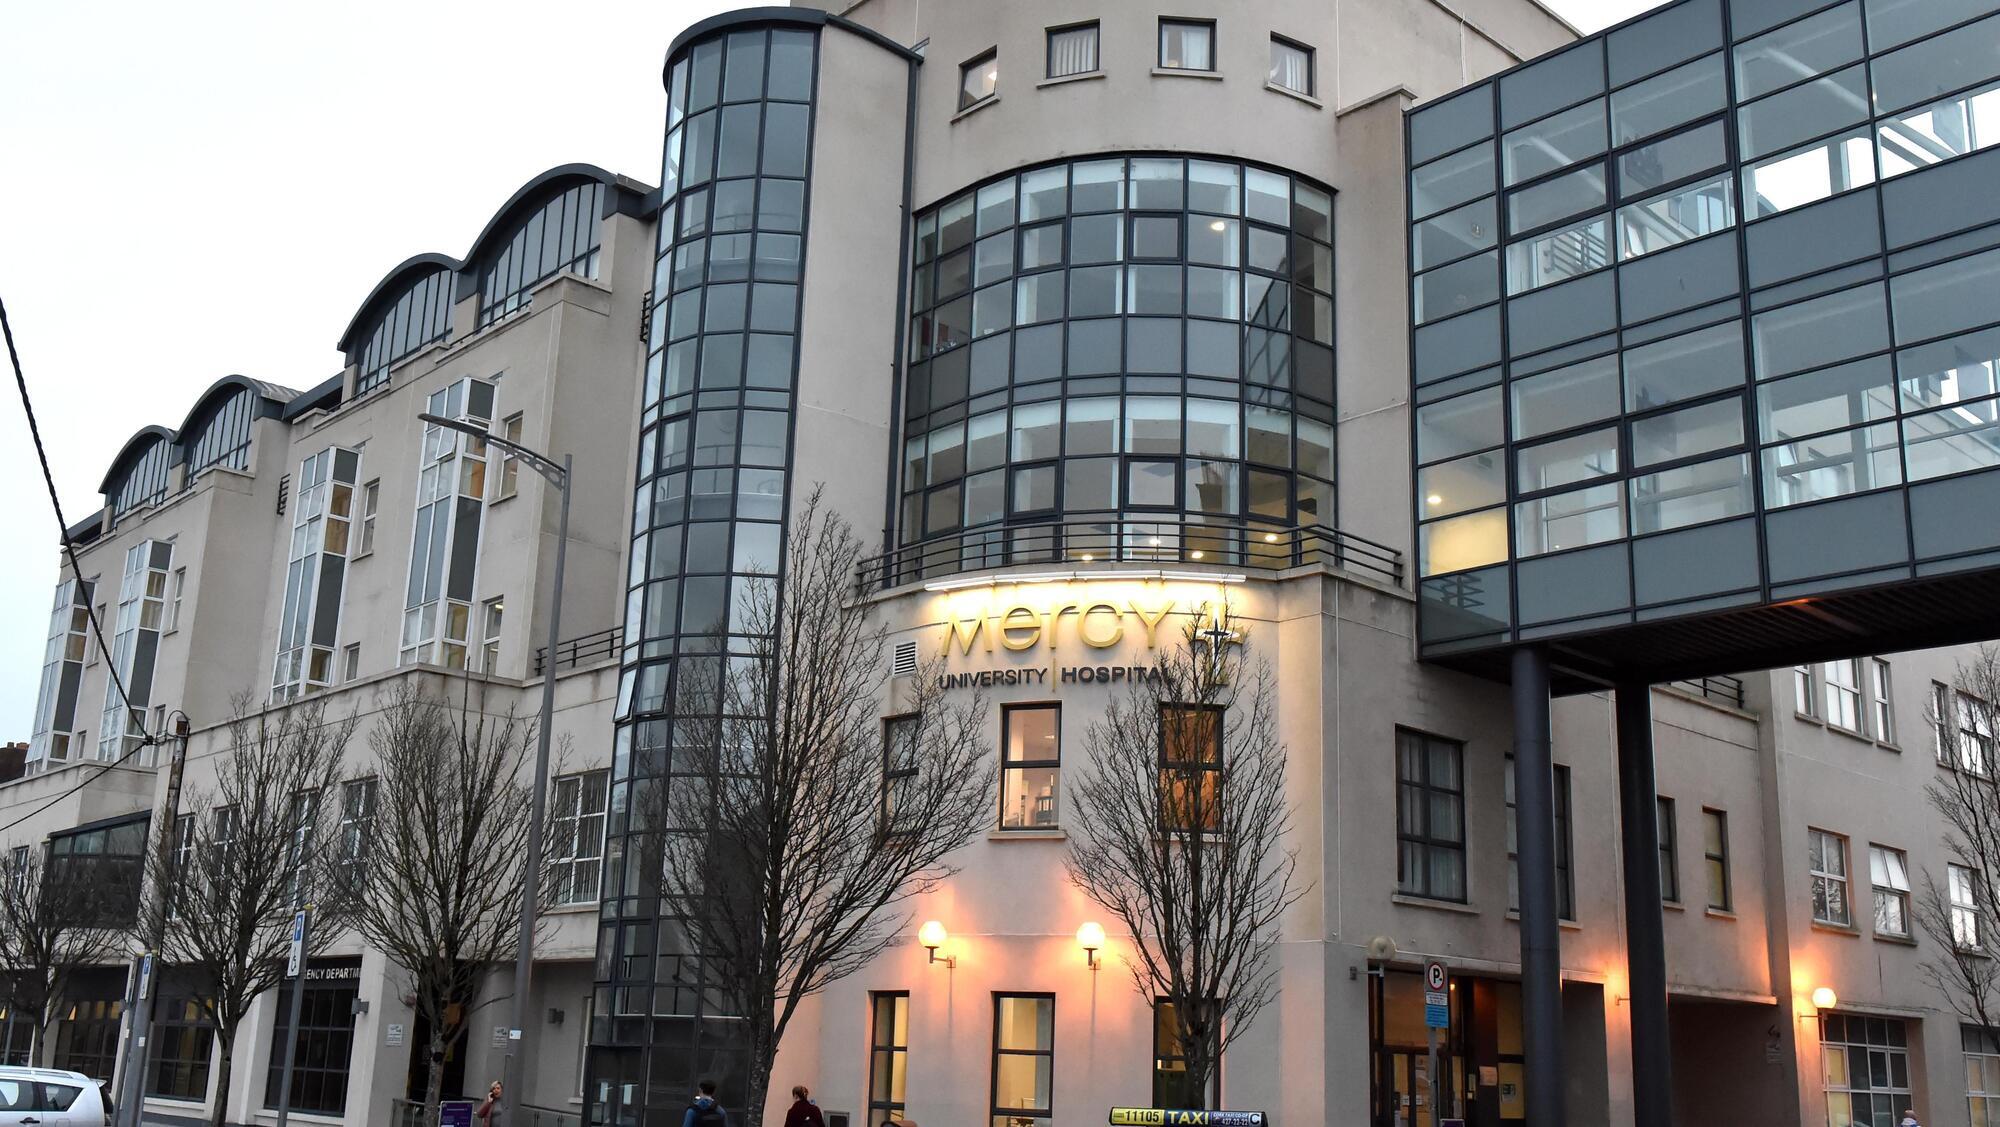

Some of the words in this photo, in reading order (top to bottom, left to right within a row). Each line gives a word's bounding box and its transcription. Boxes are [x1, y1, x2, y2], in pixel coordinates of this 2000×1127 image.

[939, 668, 1048, 690] UNIVERSITY
[326, 967, 361, 979] DEPARTM
[1126, 1110, 1159, 1122] 11105
[1168, 1111, 1209, 1125] TAXI
